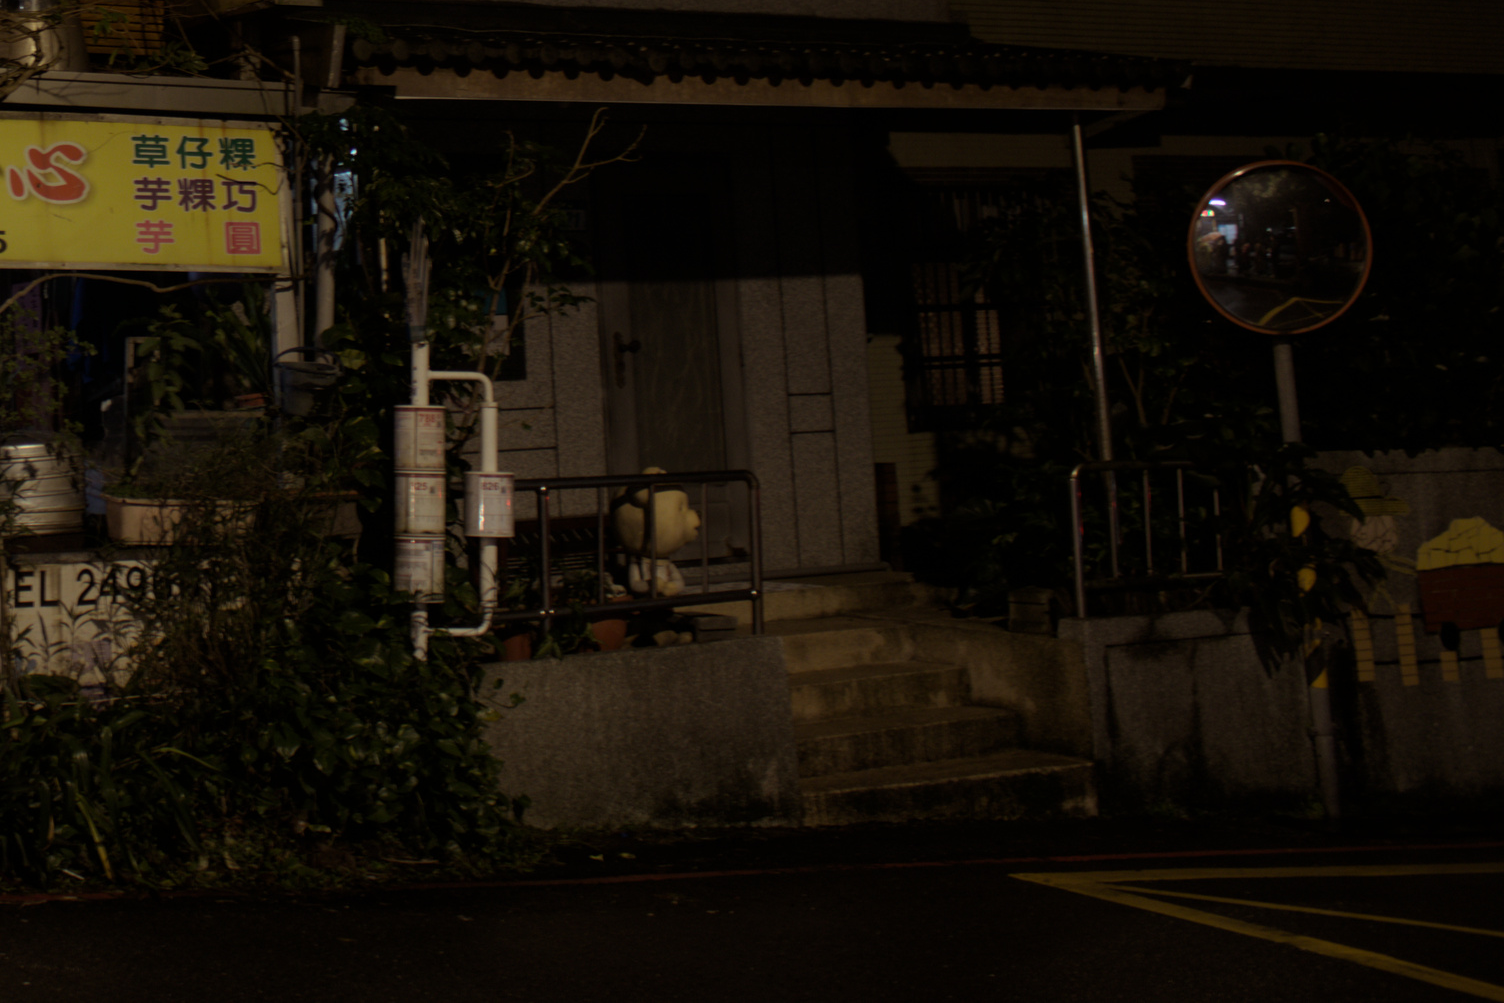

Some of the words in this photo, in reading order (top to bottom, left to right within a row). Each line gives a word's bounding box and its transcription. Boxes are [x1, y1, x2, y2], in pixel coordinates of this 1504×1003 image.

[131, 134, 257, 173] 草仔粿
[133, 176, 259, 213] 芋粿巧
